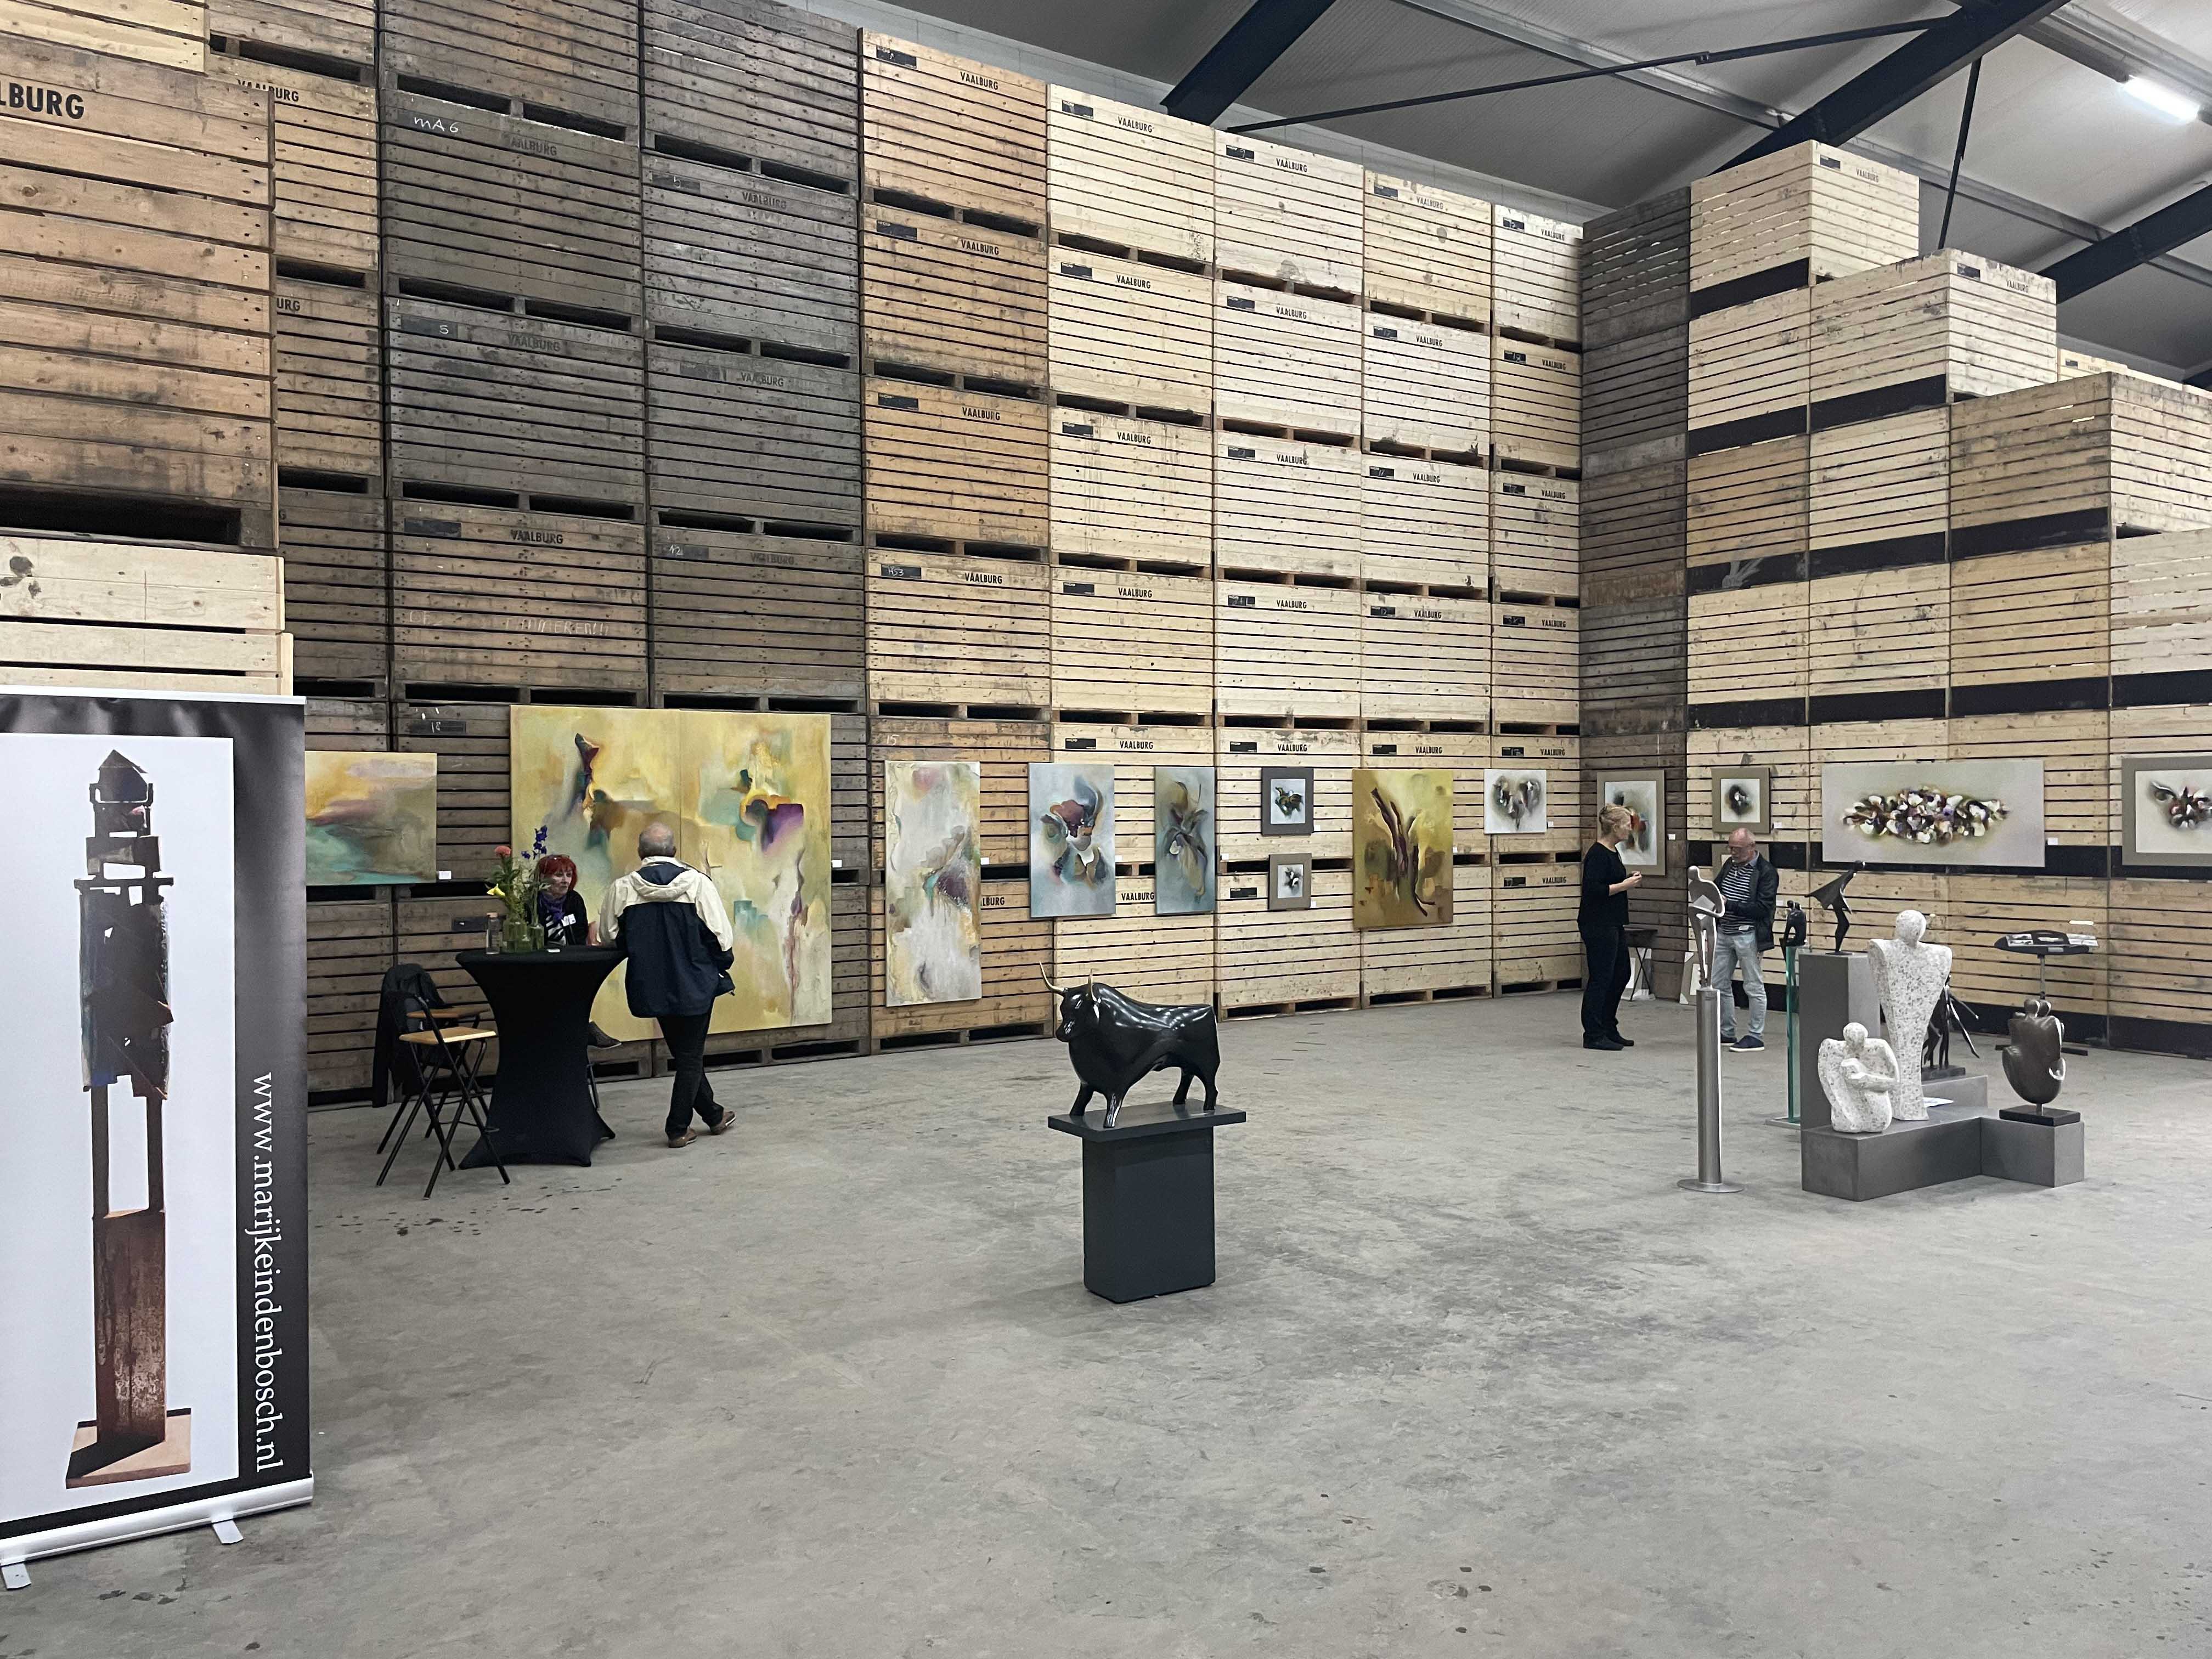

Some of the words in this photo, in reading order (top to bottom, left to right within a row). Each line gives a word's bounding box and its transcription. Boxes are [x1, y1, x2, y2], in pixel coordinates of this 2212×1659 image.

[960, 71, 999, 91] VAALBURG
[449, 122, 459, 133] 6
[1118, 116, 1153, 133] VAALBURG
[1276, 157, 1308, 173] VAALBURG
[1416, 196, 1443, 210] VAALBURG
[1541, 228, 1565, 240] VAALBURG
[961, 239, 1000, 256] VAALBURG
[1116, 274, 1152, 289] VAALBURG
[1276, 306, 1307, 320] VAALBURG
[439, 325, 449, 335] 5
[1416, 334, 1443, 347] VAALBURG
[1542, 359, 1566, 370] VAALBURG
[962, 407, 1001, 421] VAALBURG
[1117, 432, 1152, 444] VAALBURG
[1277, 454, 1307, 465] VAALBURG
[1413, 473, 1440, 483] VAALBURG
[1541, 489, 1566, 499] VAALBURG
[510, 529, 564, 544] VAALBURG
[965, 572, 1003, 584] VAALBURG
[1118, 587, 1153, 598] VAALBURG
[1277, 600, 1307, 609] VAALBURG
[1414, 610, 1442, 619] VAALBURG
[1542, 619, 1566, 628] VAALBURG
[1119, 740, 1154, 750] VAALBURG
[1277, 743, 1307, 752] VAALBURG
[1415, 746, 1442, 754] VAALBURG
[980, 896, 1005, 906] LBURG
[1121, 892, 1155, 900] VAALBURG
[245, 1071, 284, 1473] www.marijkeindenbosch.nl
